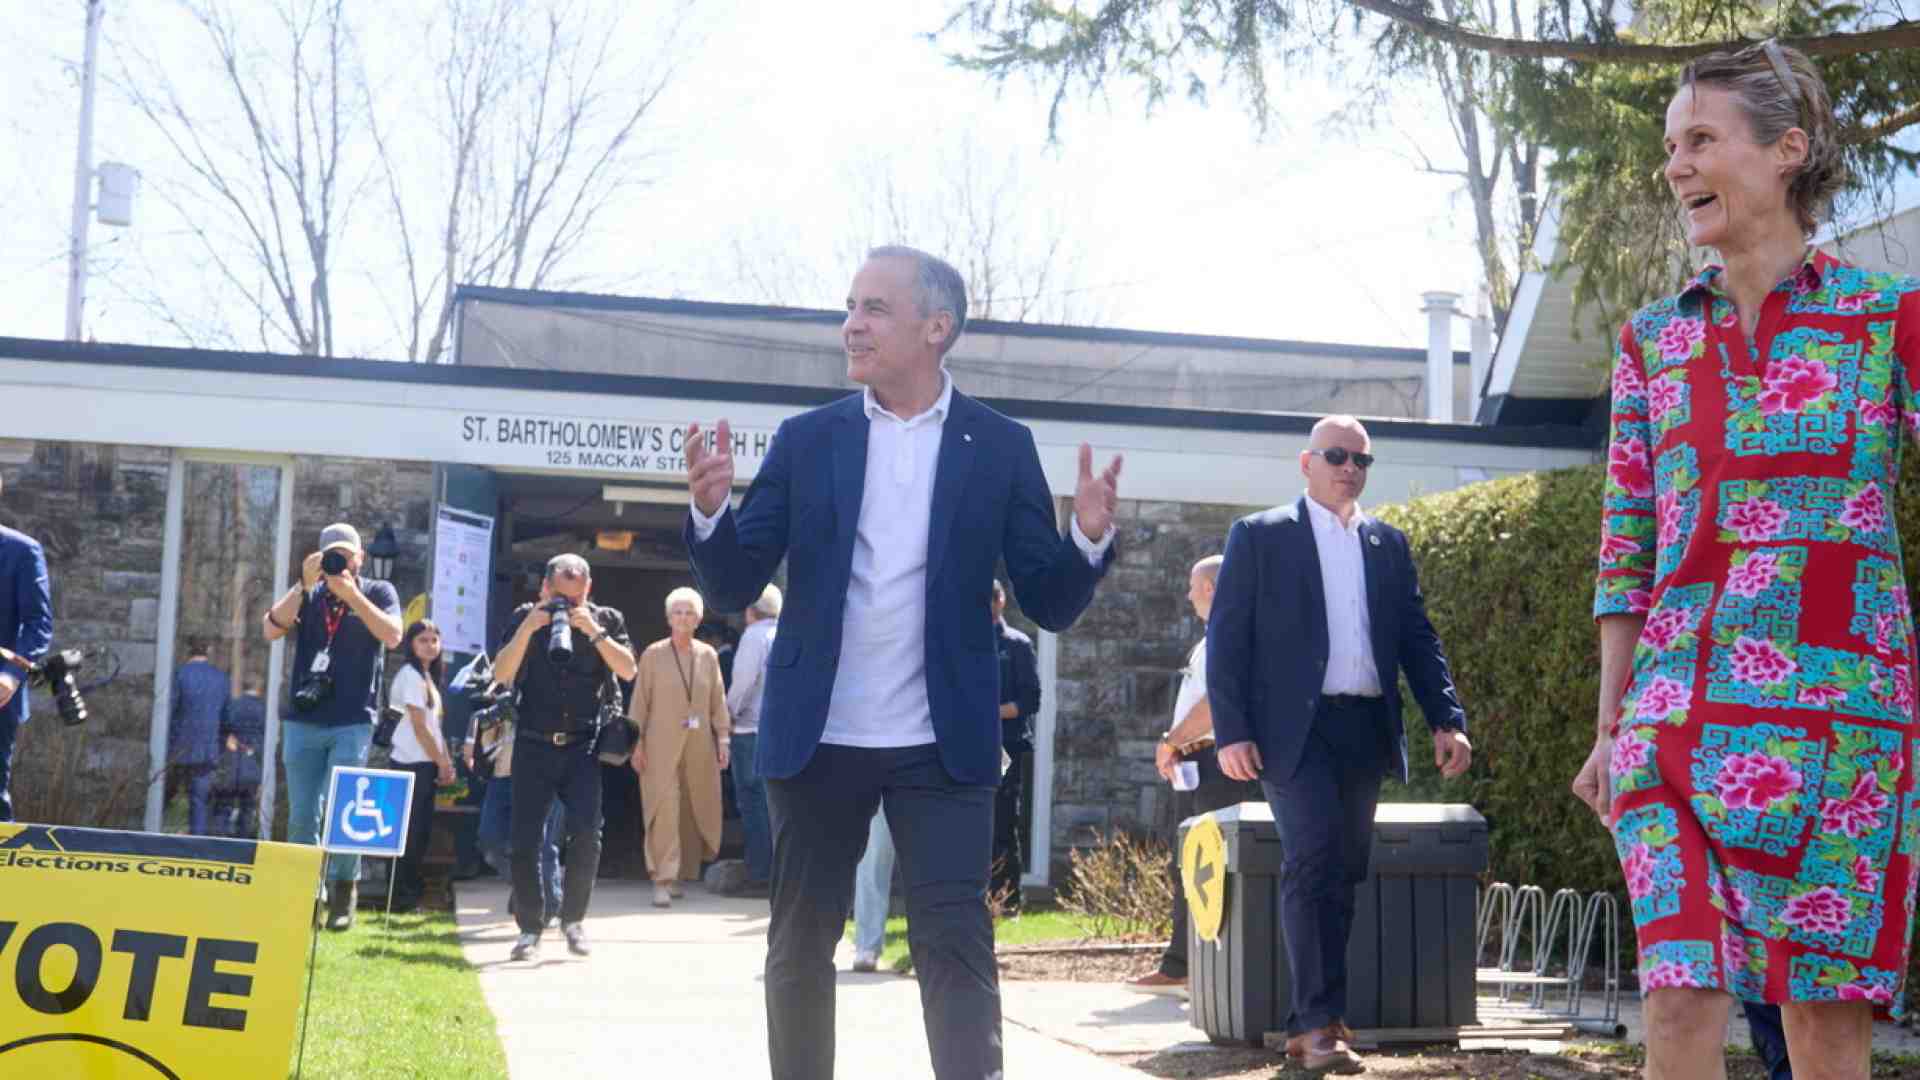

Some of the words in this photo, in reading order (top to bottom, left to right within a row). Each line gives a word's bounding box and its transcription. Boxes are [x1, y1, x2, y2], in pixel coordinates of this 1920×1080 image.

[462, 415, 488, 441] ST.
[498, 418, 662, 452] BARTHOLOMEW'S
[670, 427, 746, 457] CRH
[547, 450, 572, 465] 125
[578, 452, 649, 469] MACKAY
[656, 456, 689, 472] STR
[137, 860, 251, 885] Canada
[0, 920, 259, 1032] OTE
